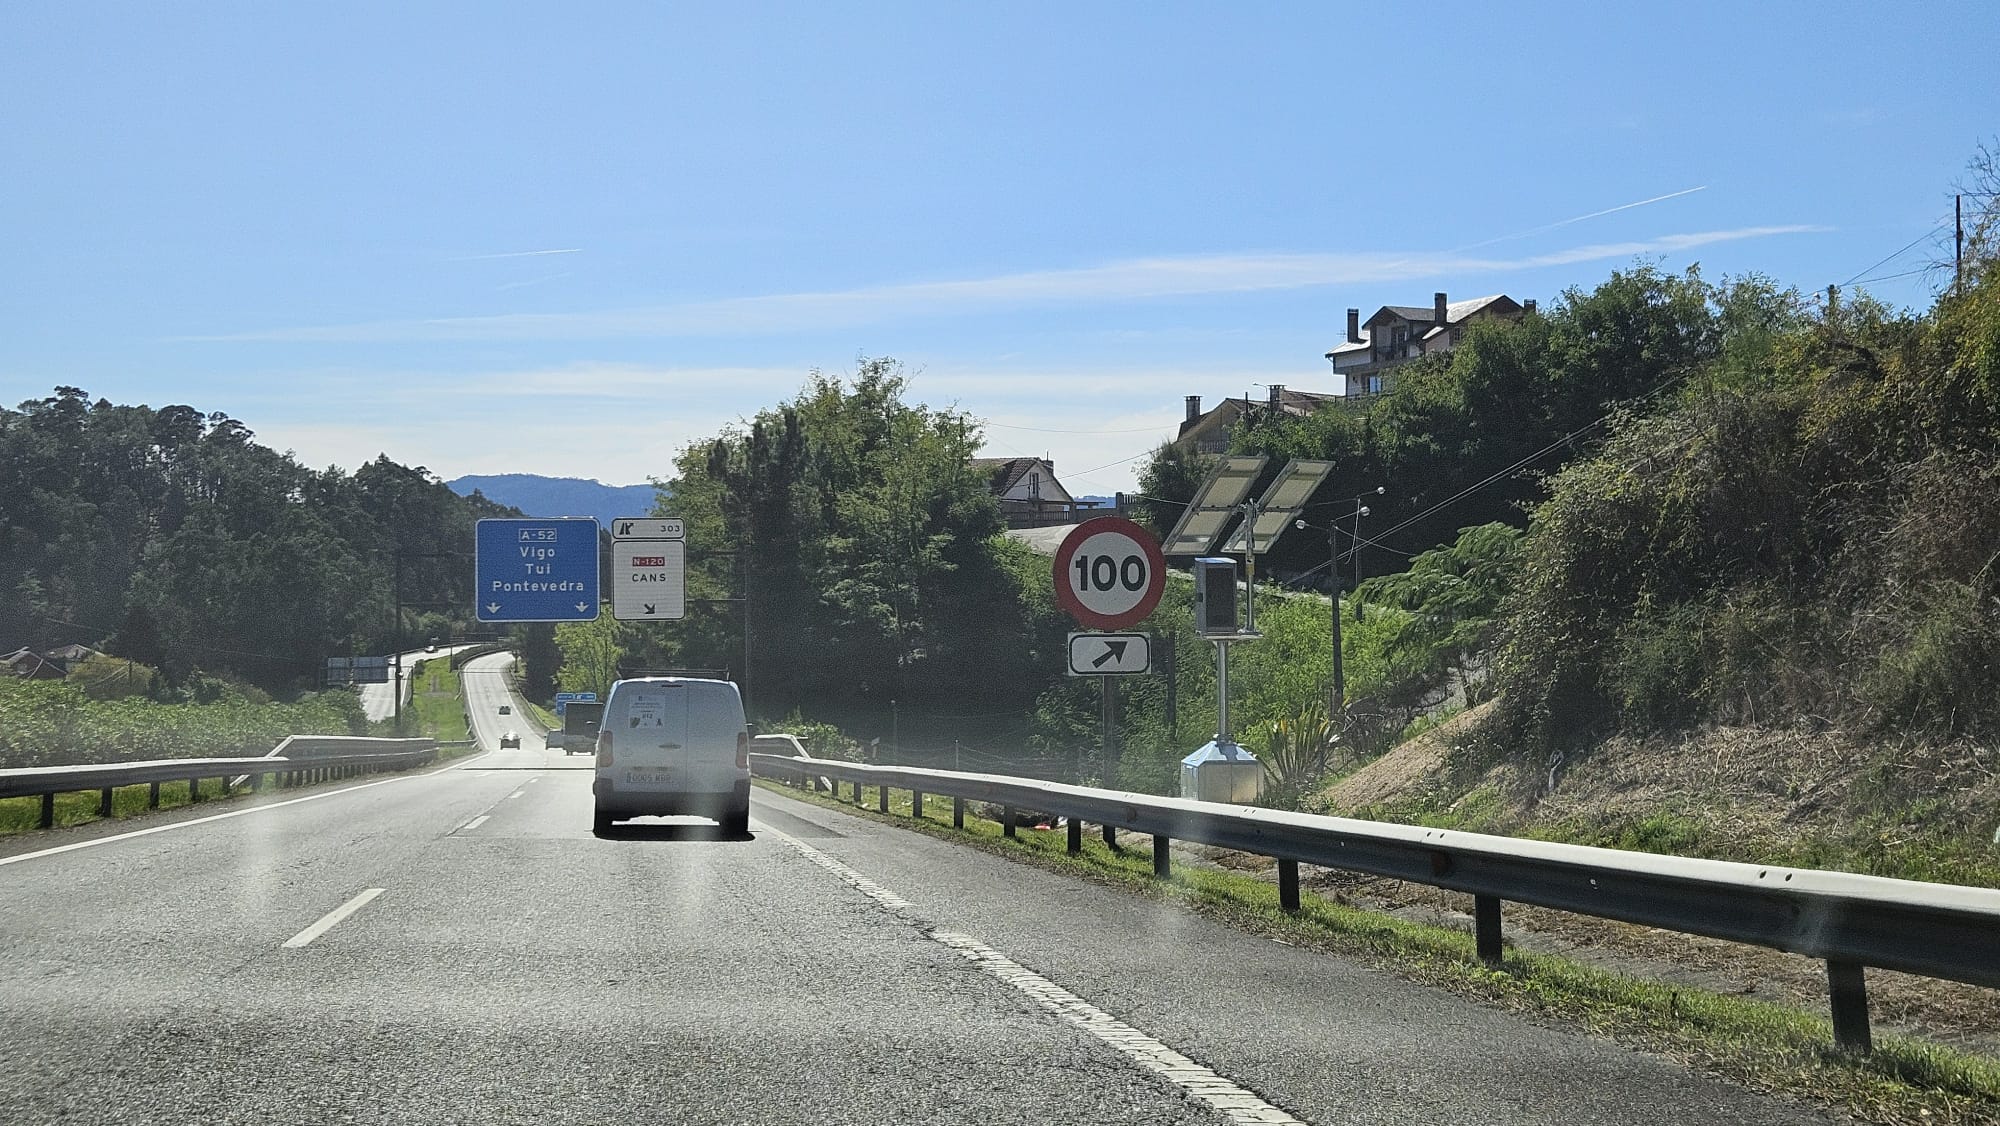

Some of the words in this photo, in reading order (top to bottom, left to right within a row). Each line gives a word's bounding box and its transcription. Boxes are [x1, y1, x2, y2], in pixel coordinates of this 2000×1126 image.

[521, 531, 556, 540] A-52
[520, 547, 556, 560] Vigo
[633, 558, 664, 566] N-120
[525, 563, 551, 575] Tui
[1075, 554, 1147, 592] 100
[632, 573, 666, 582] CANS
[492, 580, 584, 592] Pontevedra
